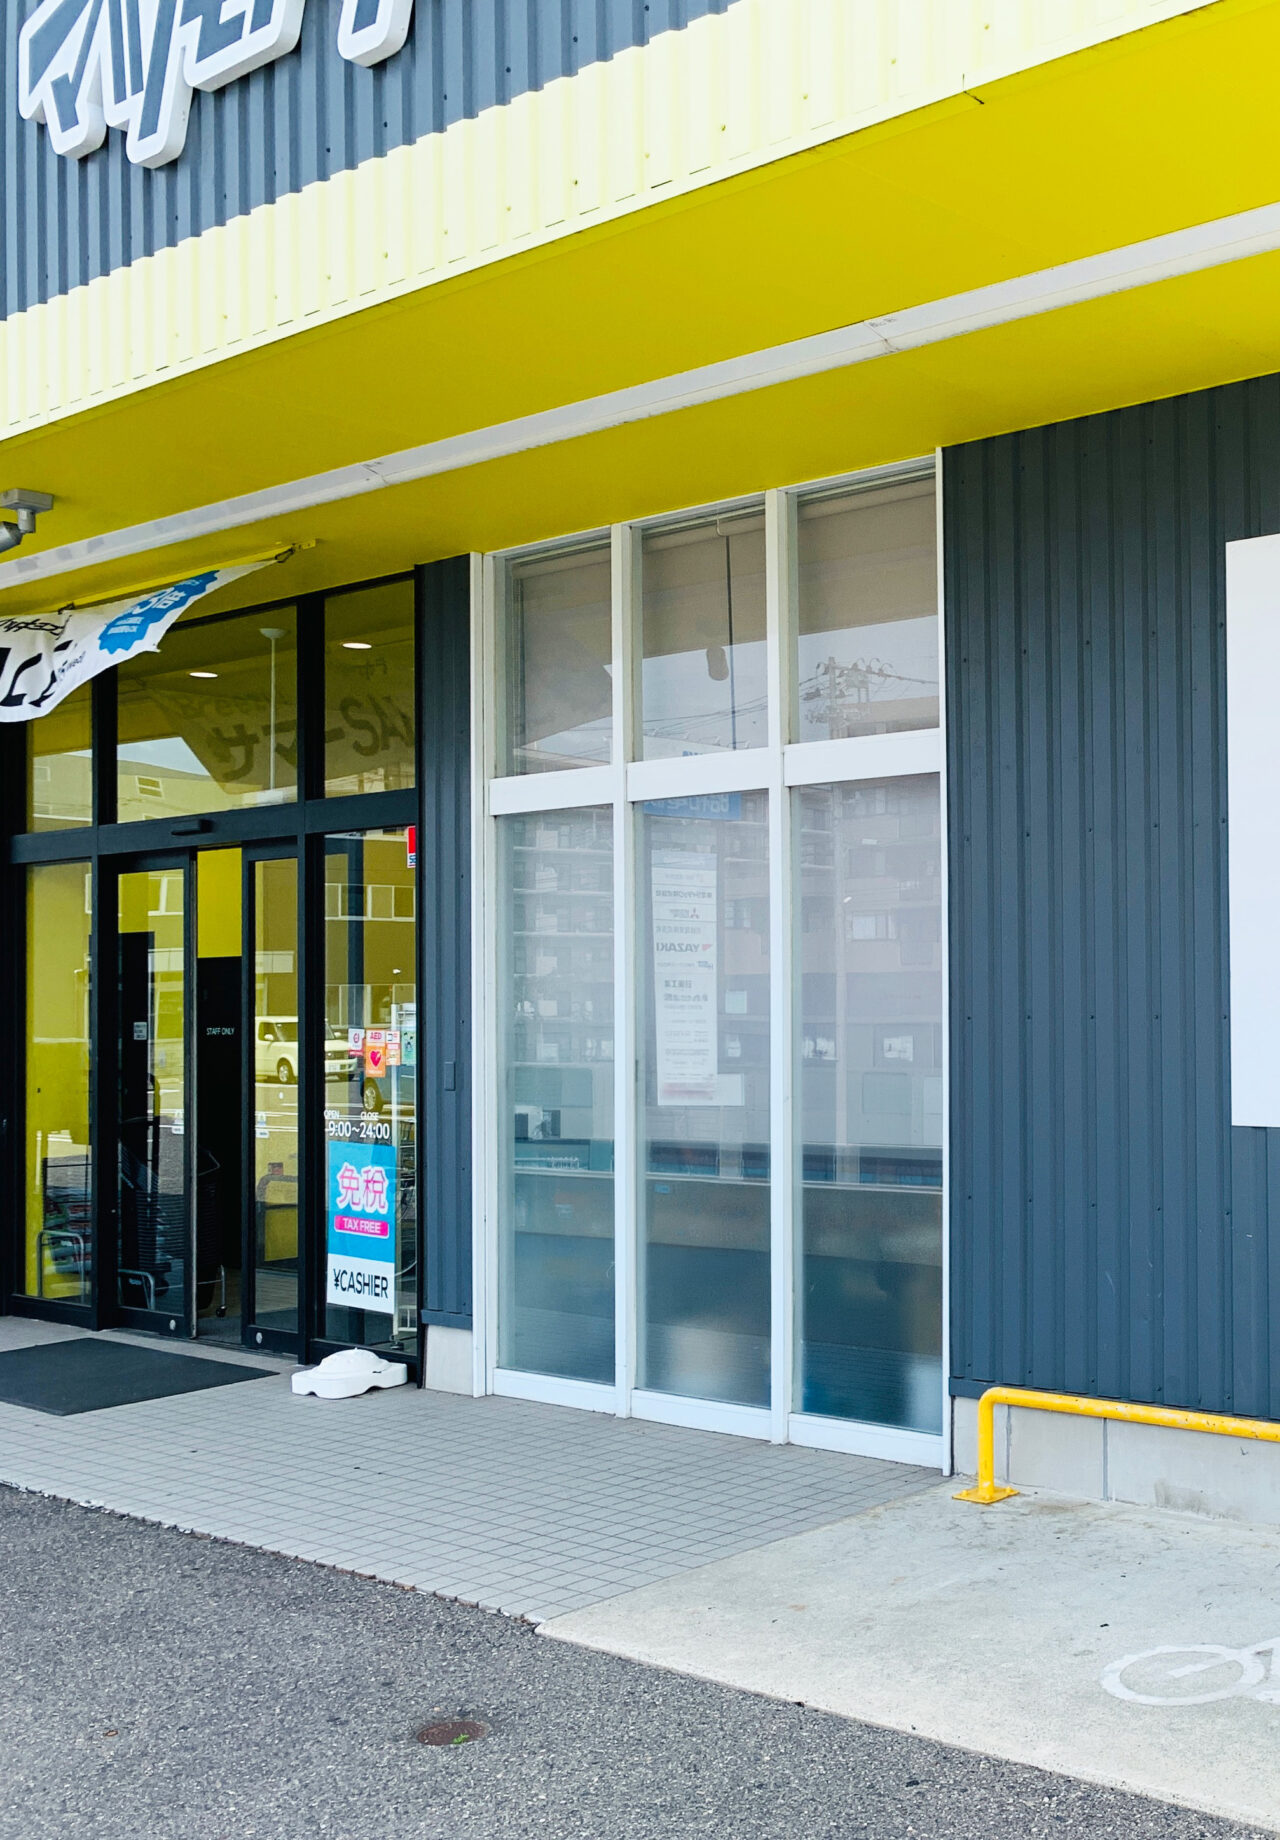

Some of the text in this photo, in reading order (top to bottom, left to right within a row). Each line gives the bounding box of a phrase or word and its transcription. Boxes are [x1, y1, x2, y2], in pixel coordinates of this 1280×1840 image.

[206, 1027, 235, 1036] STAFF ONLY
[369, 1031, 382, 1041] AED
[323, 1109, 379, 1121] OPEN CLOSE
[337, 1163, 388, 1213] 免税
[342, 1217, 382, 1234] TAX FREE
